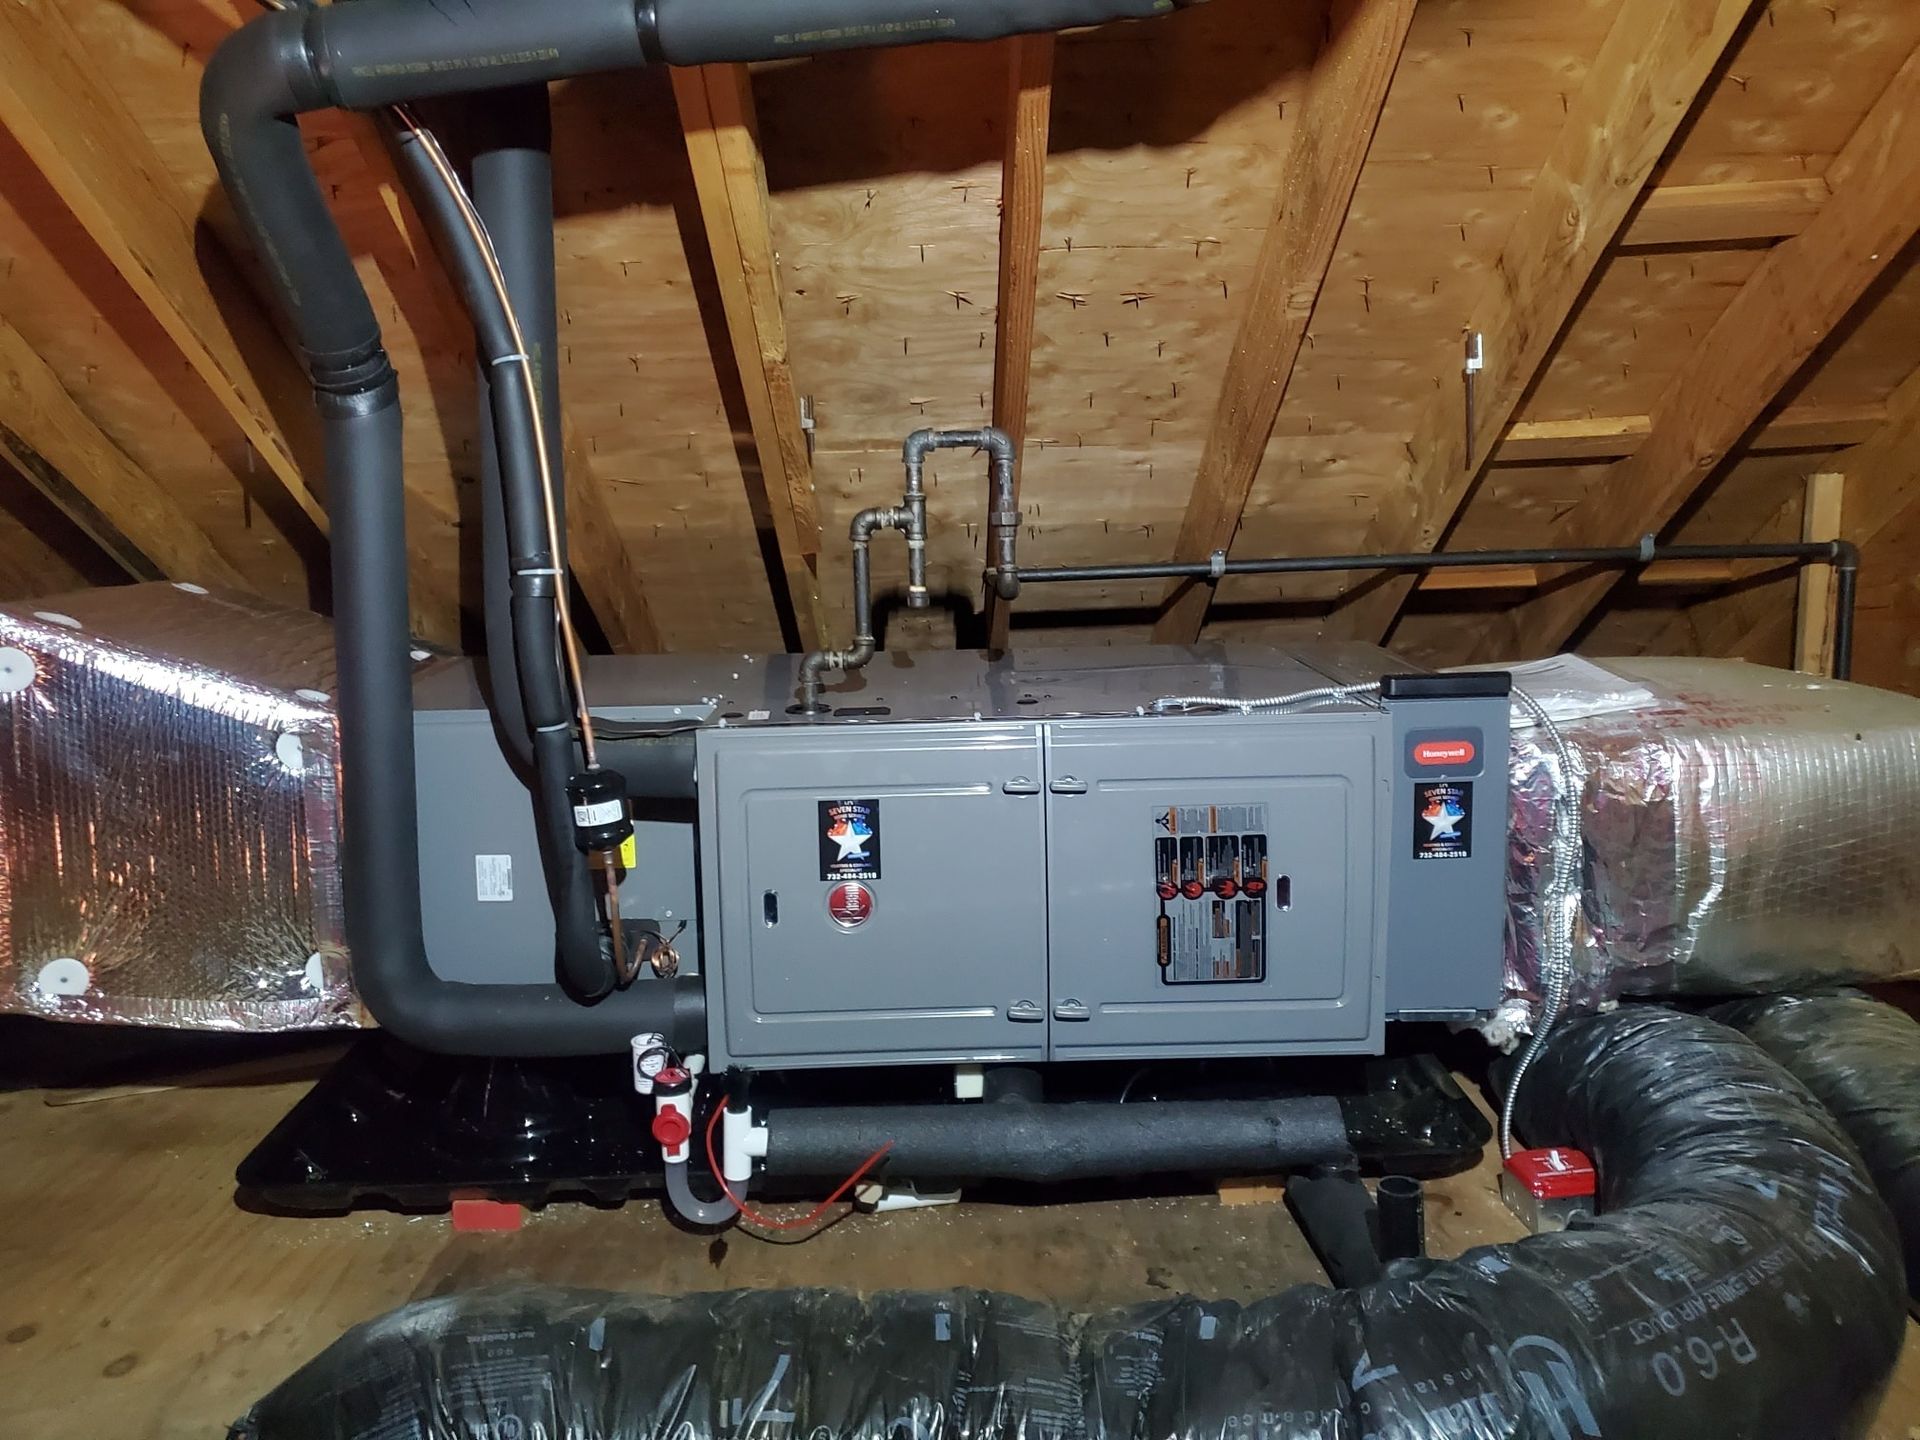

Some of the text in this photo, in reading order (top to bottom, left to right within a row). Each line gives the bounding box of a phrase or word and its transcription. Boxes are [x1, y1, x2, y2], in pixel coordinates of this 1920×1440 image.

[1422, 748, 1466, 759] Honeywell
[1424, 788, 1447, 798] SEVEN
[828, 805, 852, 816] SEVEN
[1629, 1310, 1682, 1345] DUCT
[1651, 1317, 1757, 1396] R-6.0
